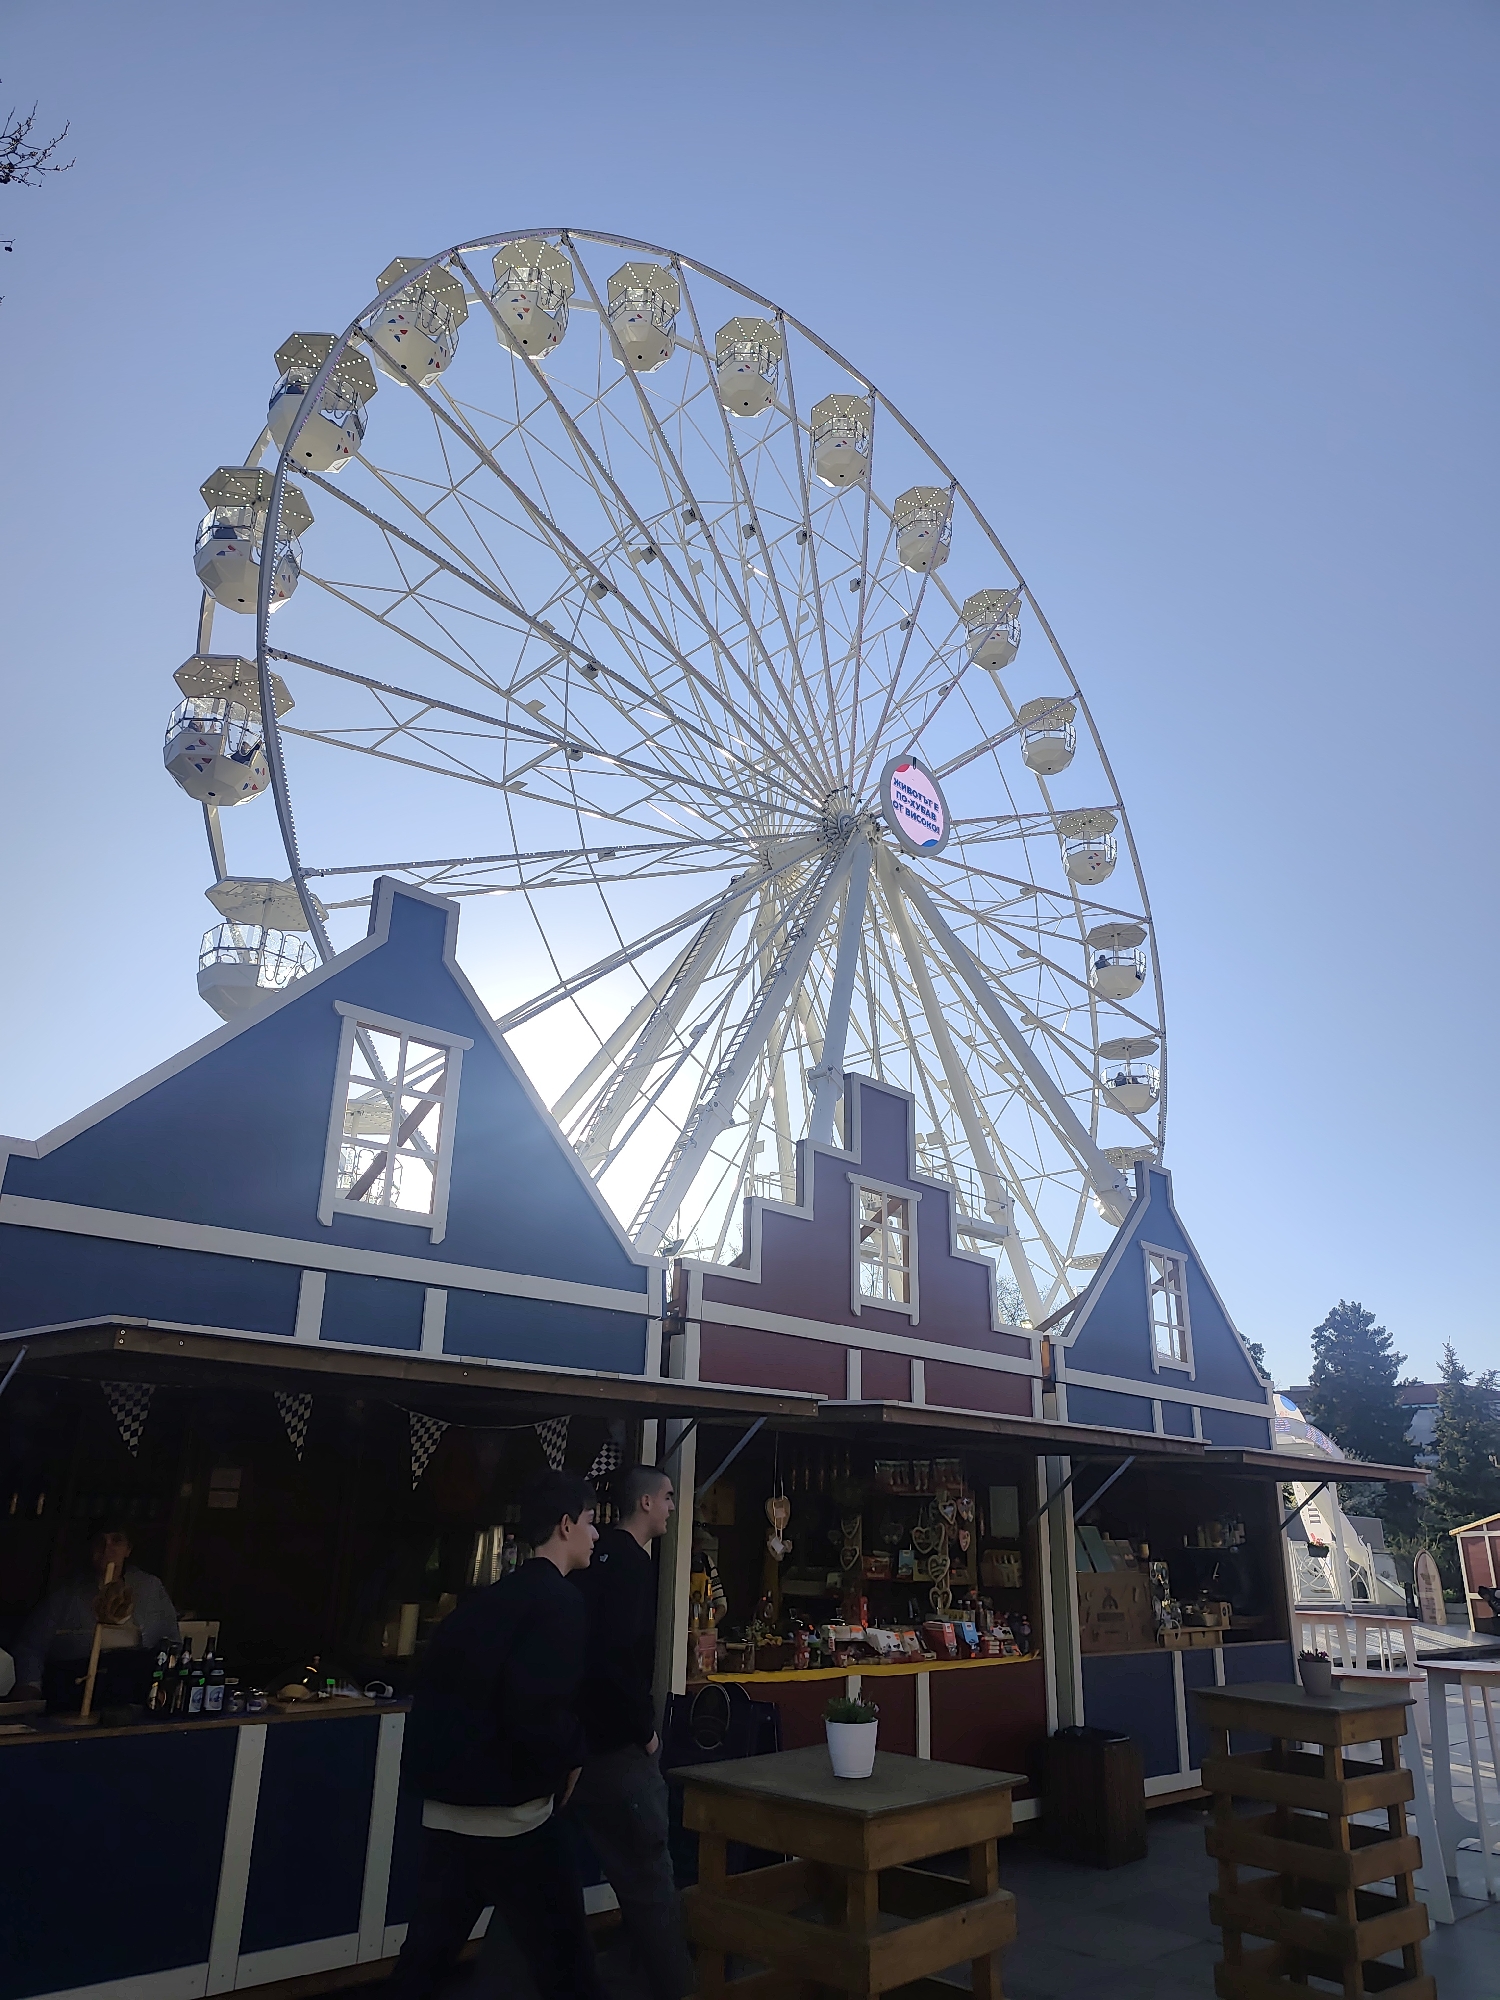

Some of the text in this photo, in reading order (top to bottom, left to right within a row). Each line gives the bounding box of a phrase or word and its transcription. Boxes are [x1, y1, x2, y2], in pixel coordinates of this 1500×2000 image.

[894, 777, 932, 807] ЖИВОТЪТ
[896, 790, 936, 820] ПО-ХУБАВ
[893, 800, 940, 834] ОТ ВИСОКО!
